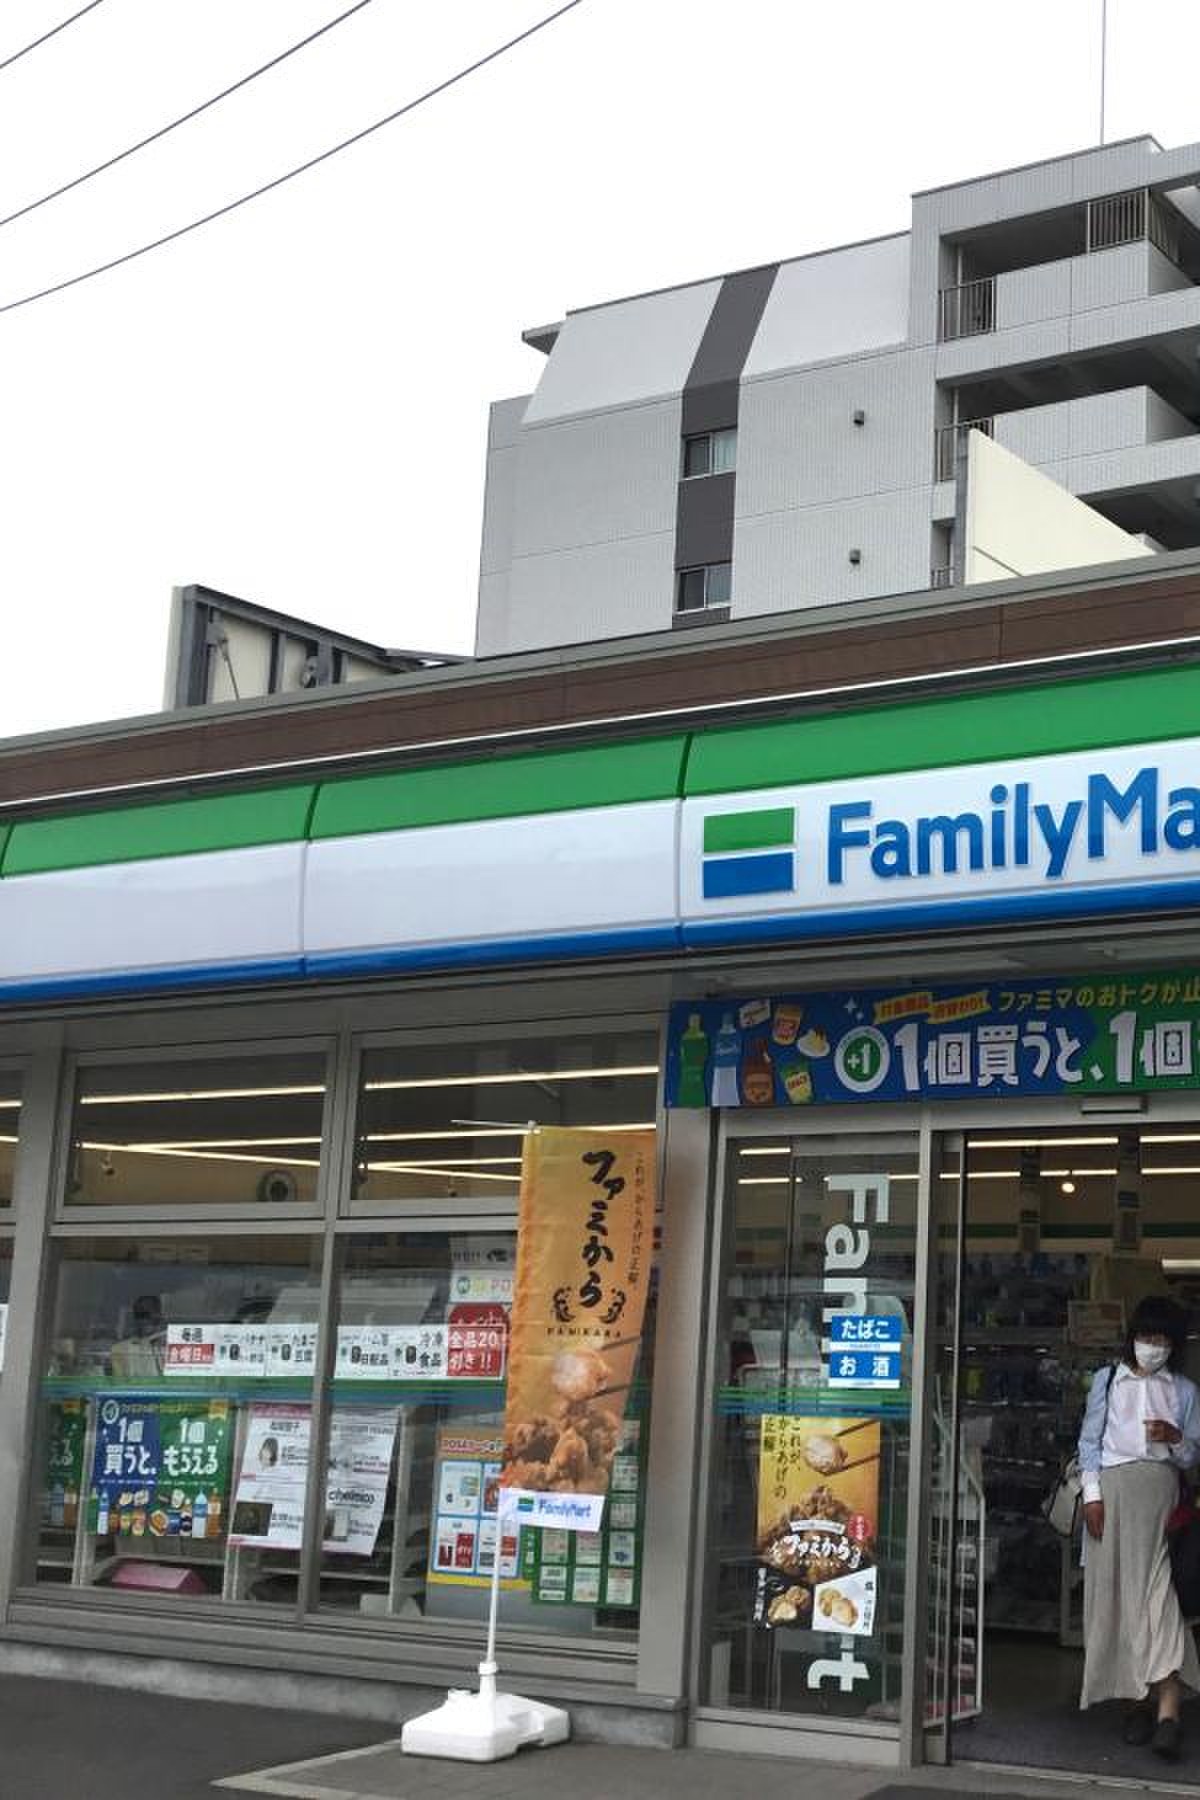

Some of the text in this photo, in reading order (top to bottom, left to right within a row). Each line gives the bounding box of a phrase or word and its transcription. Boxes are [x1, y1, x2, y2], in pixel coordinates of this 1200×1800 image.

[581, 1149, 627, 1308] ファミから
[841, 1319, 891, 1341] たばこ
